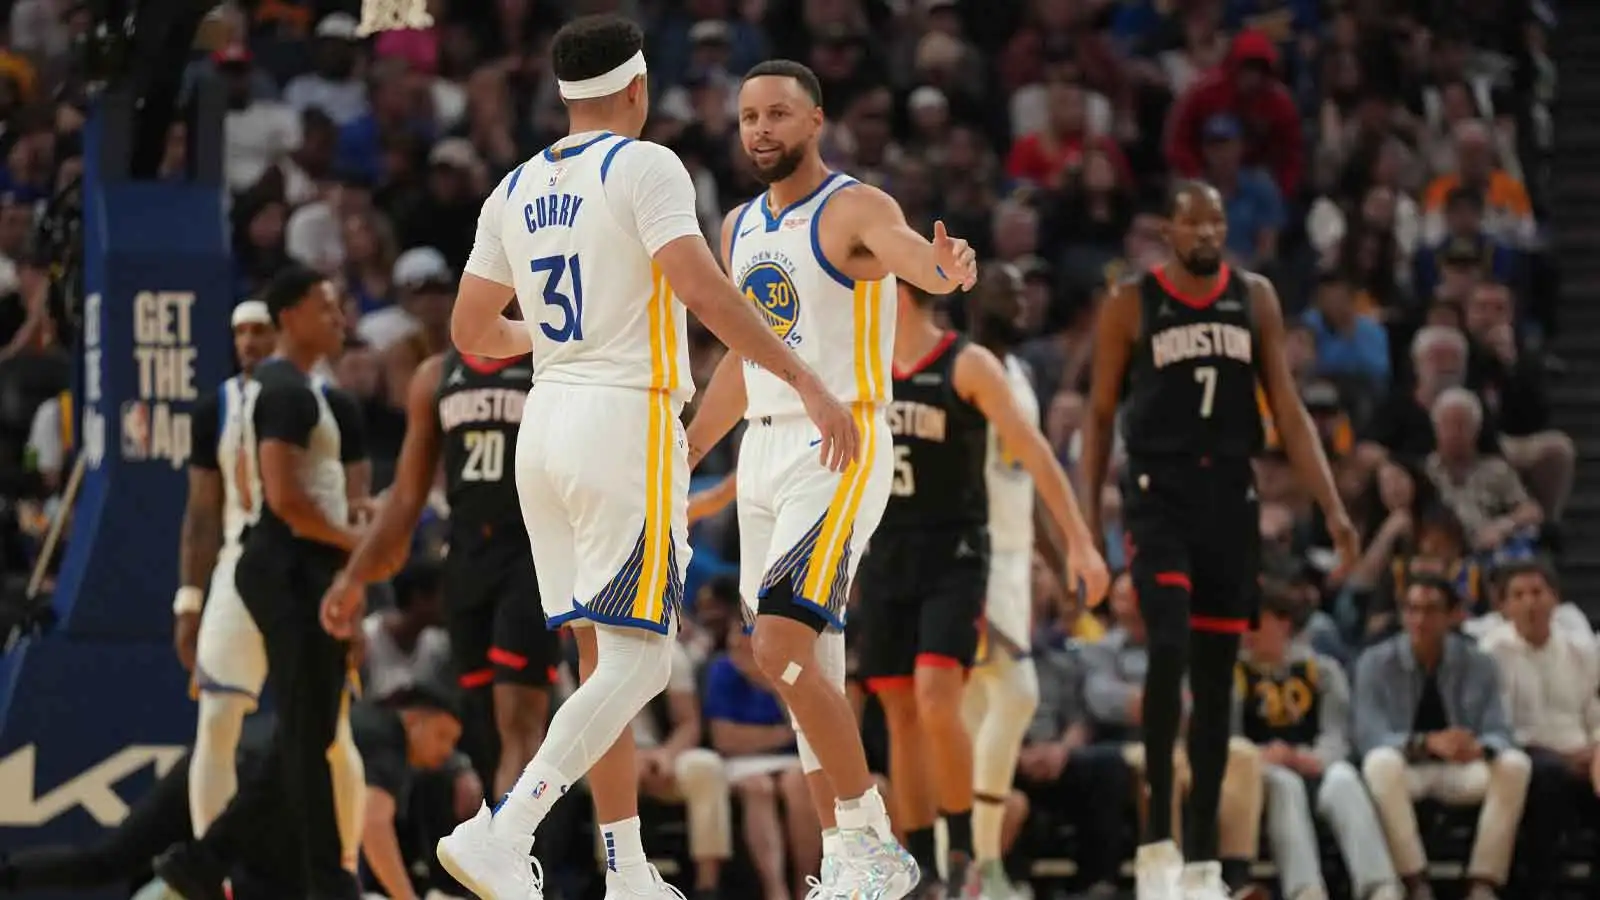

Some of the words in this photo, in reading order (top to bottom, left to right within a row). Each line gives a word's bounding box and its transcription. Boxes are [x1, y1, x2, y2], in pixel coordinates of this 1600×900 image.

[523, 193, 583, 234] CURRY
[774, 252, 796, 276] STATE
[133, 291, 197, 345] GET
[530, 253, 583, 342] 31
[765, 281, 790, 309] 30
[1151, 321, 1252, 369] HOUSTON
[133, 346, 198, 399] THE
[1194, 366, 1218, 418] 7
[151, 401, 192, 470] Ap
[886, 400, 947, 442] STON
[461, 429, 505, 481] 20
